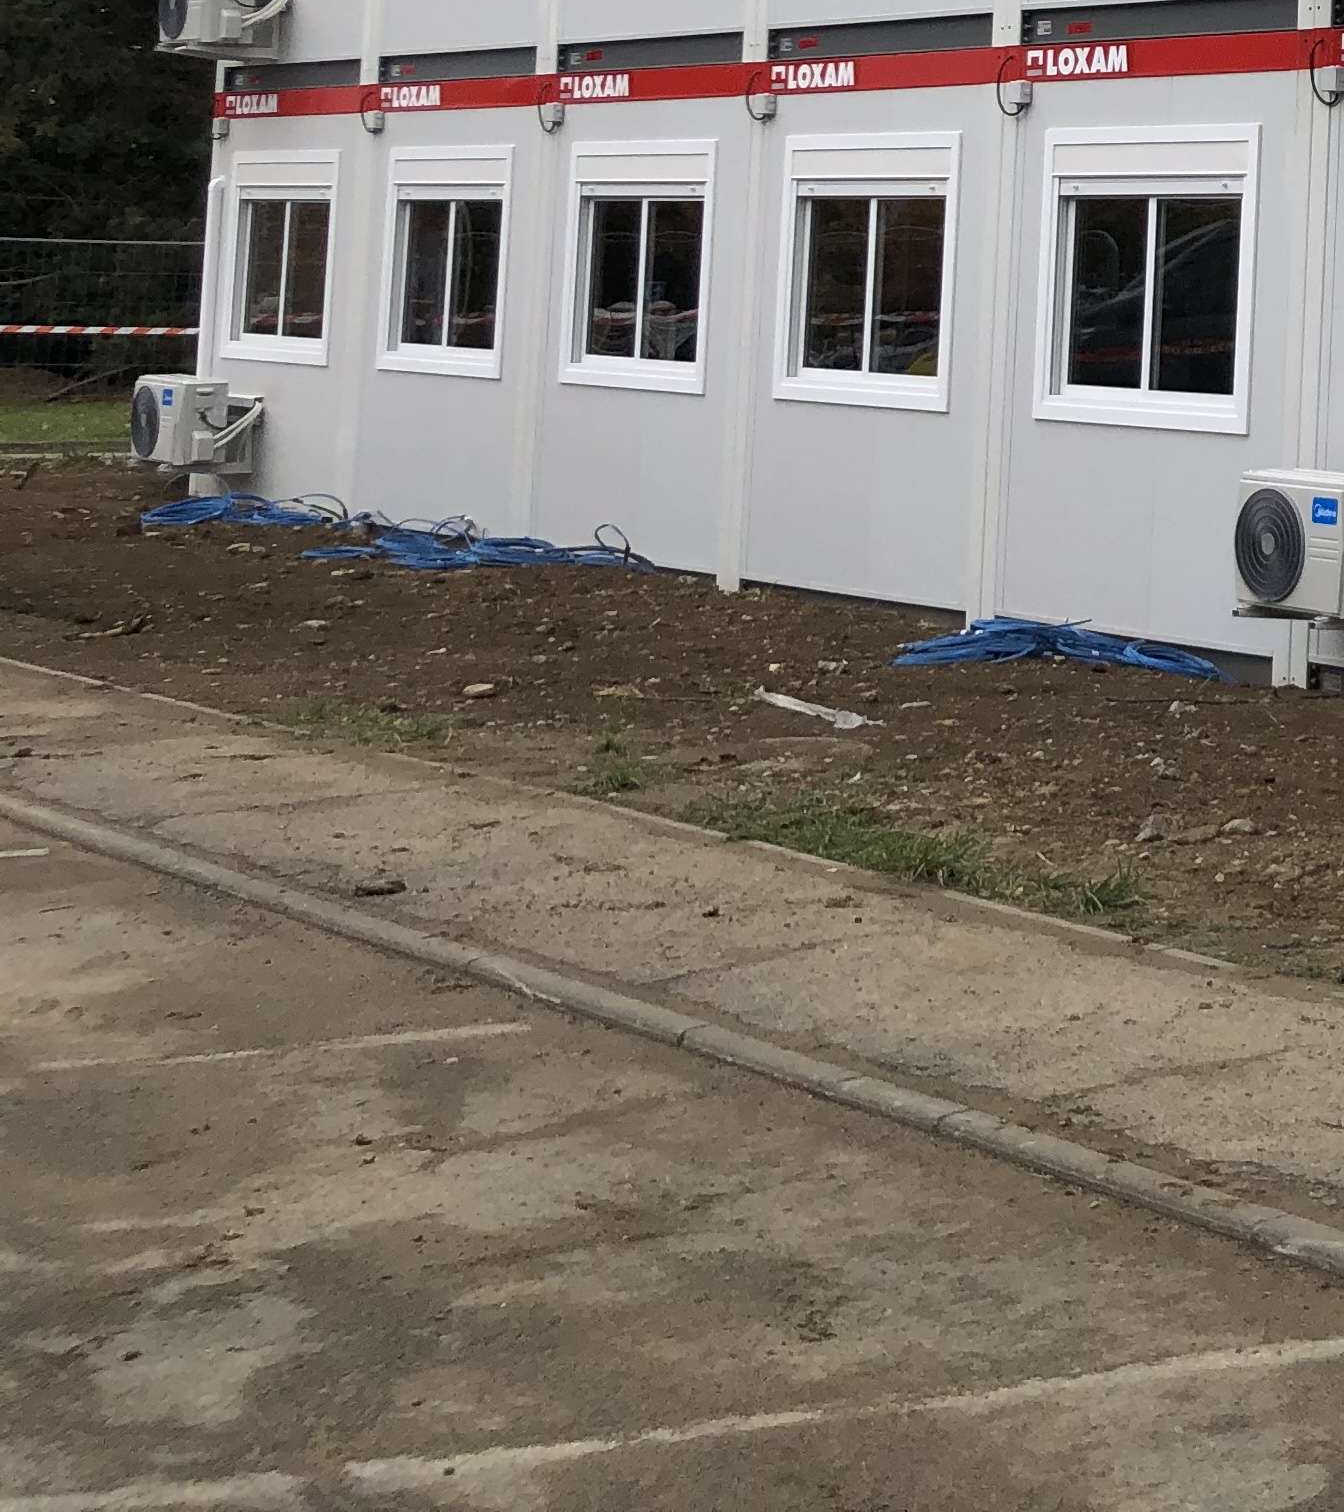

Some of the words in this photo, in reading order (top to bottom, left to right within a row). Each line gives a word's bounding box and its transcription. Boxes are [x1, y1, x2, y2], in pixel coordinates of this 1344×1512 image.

[1046, 45, 1128, 76] LOXAM
[573, 74, 629, 99] LOXAM
[787, 61, 855, 89] LOXAM
[235, 94, 278, 114] LOXAM
[391, 85, 441, 107] LOXAM
